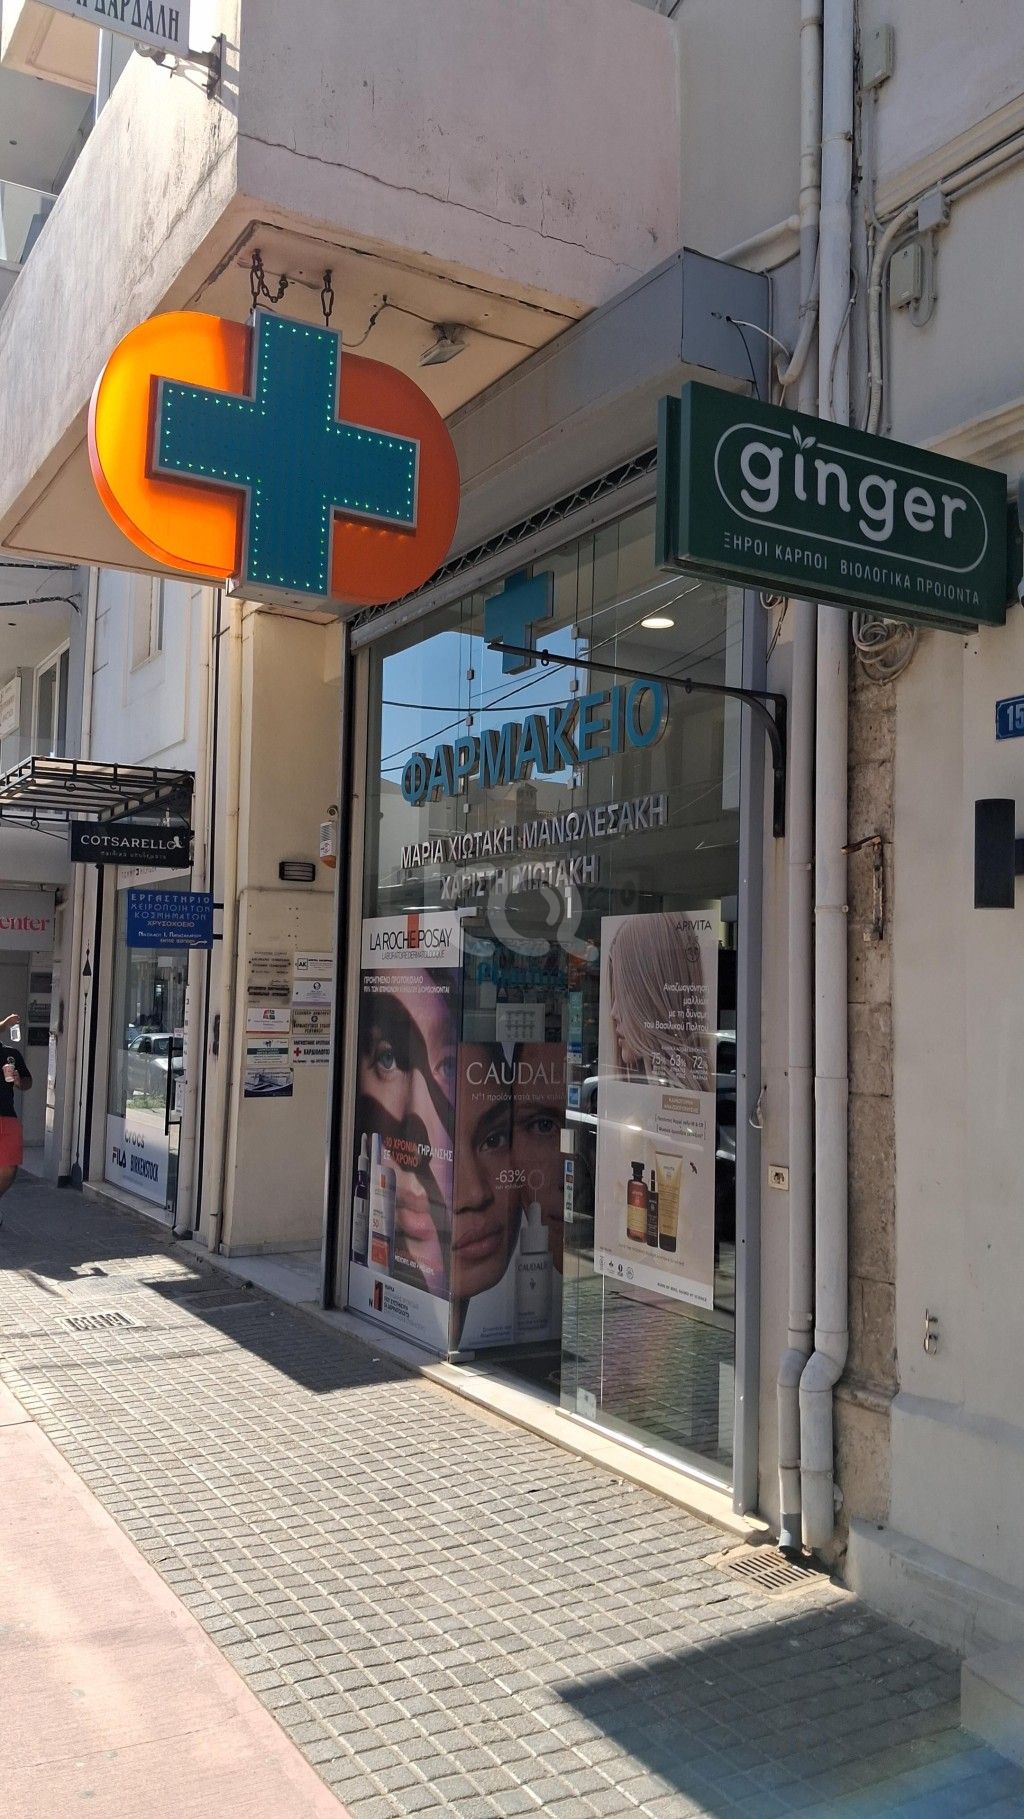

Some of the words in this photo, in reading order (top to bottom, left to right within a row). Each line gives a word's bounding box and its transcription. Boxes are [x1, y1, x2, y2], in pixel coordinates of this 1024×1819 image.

[740, 441, 967, 541] ginger
[724, 532, 768, 557] ΞΗΡΟΙ
[775, 541, 828, 570] ΚΑΡΠΟΙ
[840, 559, 911, 591] ΒΙΟΛΟΓΙΚΑ
[917, 577, 979, 605] ΠΡΟΙΟΝΤΑ
[401, 679, 668, 807] ΦΑΡΜΑΚΕΙΟ
[80, 834, 178, 850] COTSARELLO
[401, 839, 444, 870] ΜΑΡΙΑ
[449, 825, 518, 862] ΧΙΩΤΑΚΗ
[522, 794, 669, 851] ΜΑΝΩΛΕΣΑΚΗ
[131, 893, 210, 904] ΕΡΓΑΣΤΗΡΙΟ
[676, 920, 712, 931] APIVITA
[370, 933, 382, 950] LA
[382, 930, 419, 949] ROCHE
[418, 928, 452, 948] POSAY
[112, 1146, 127, 1168] FILA
[496, 1169, 526, 1183] -63%
